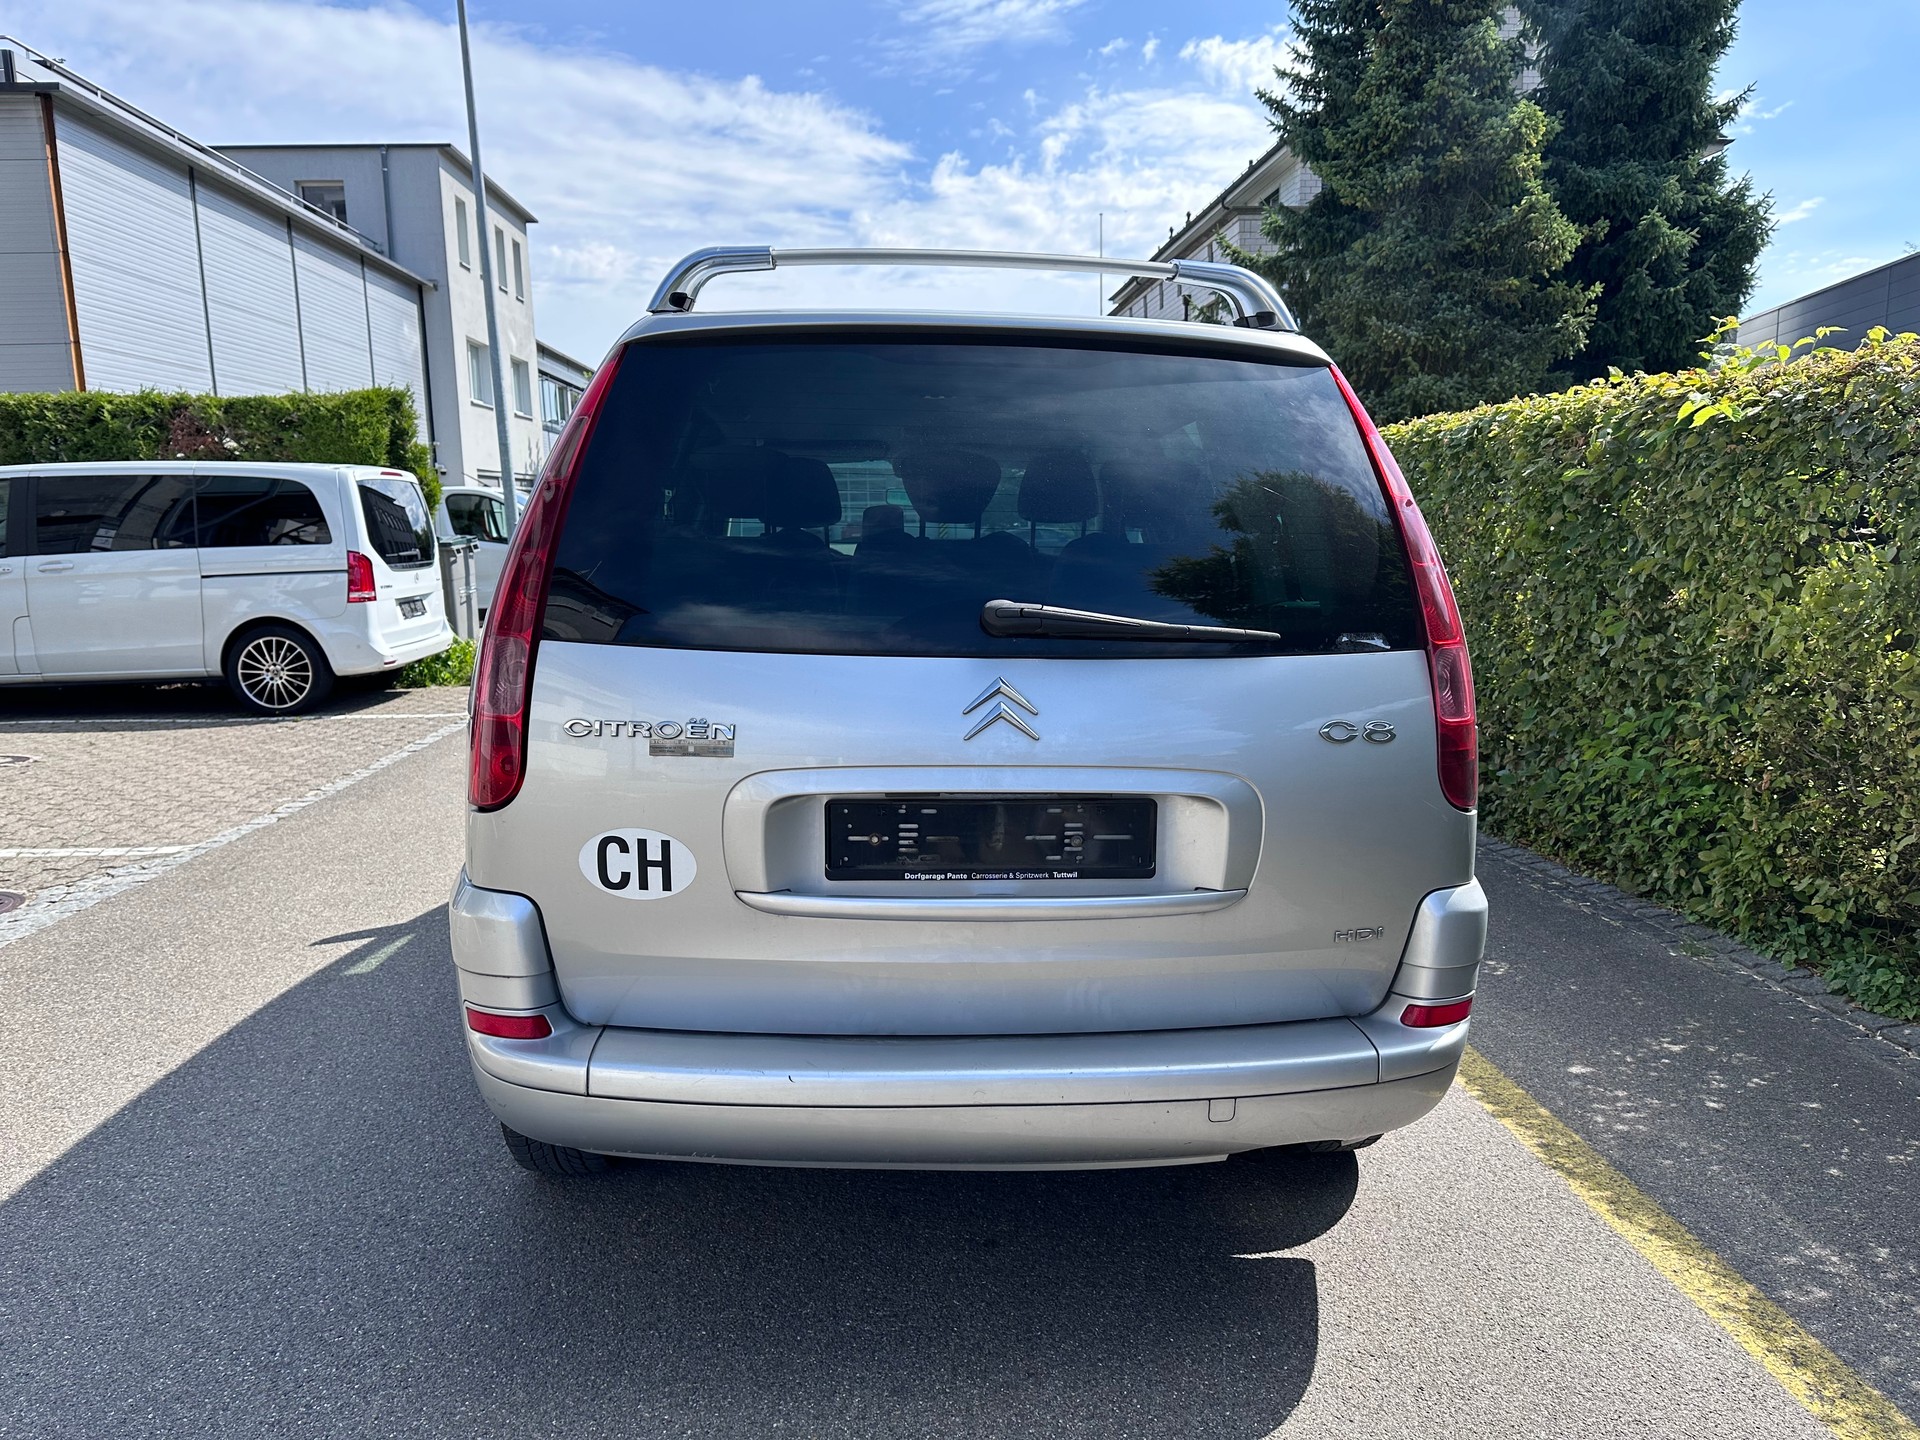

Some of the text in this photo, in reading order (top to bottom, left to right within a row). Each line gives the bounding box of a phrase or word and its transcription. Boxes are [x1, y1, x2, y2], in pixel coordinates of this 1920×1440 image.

[563, 717, 736, 740] CITROËN
[1319, 719, 1397, 744] C8
[597, 835, 672, 892] CH
[904, 872, 945, 880] Dorfgarage
[1015, 871, 1049, 879] Spritzwerk
